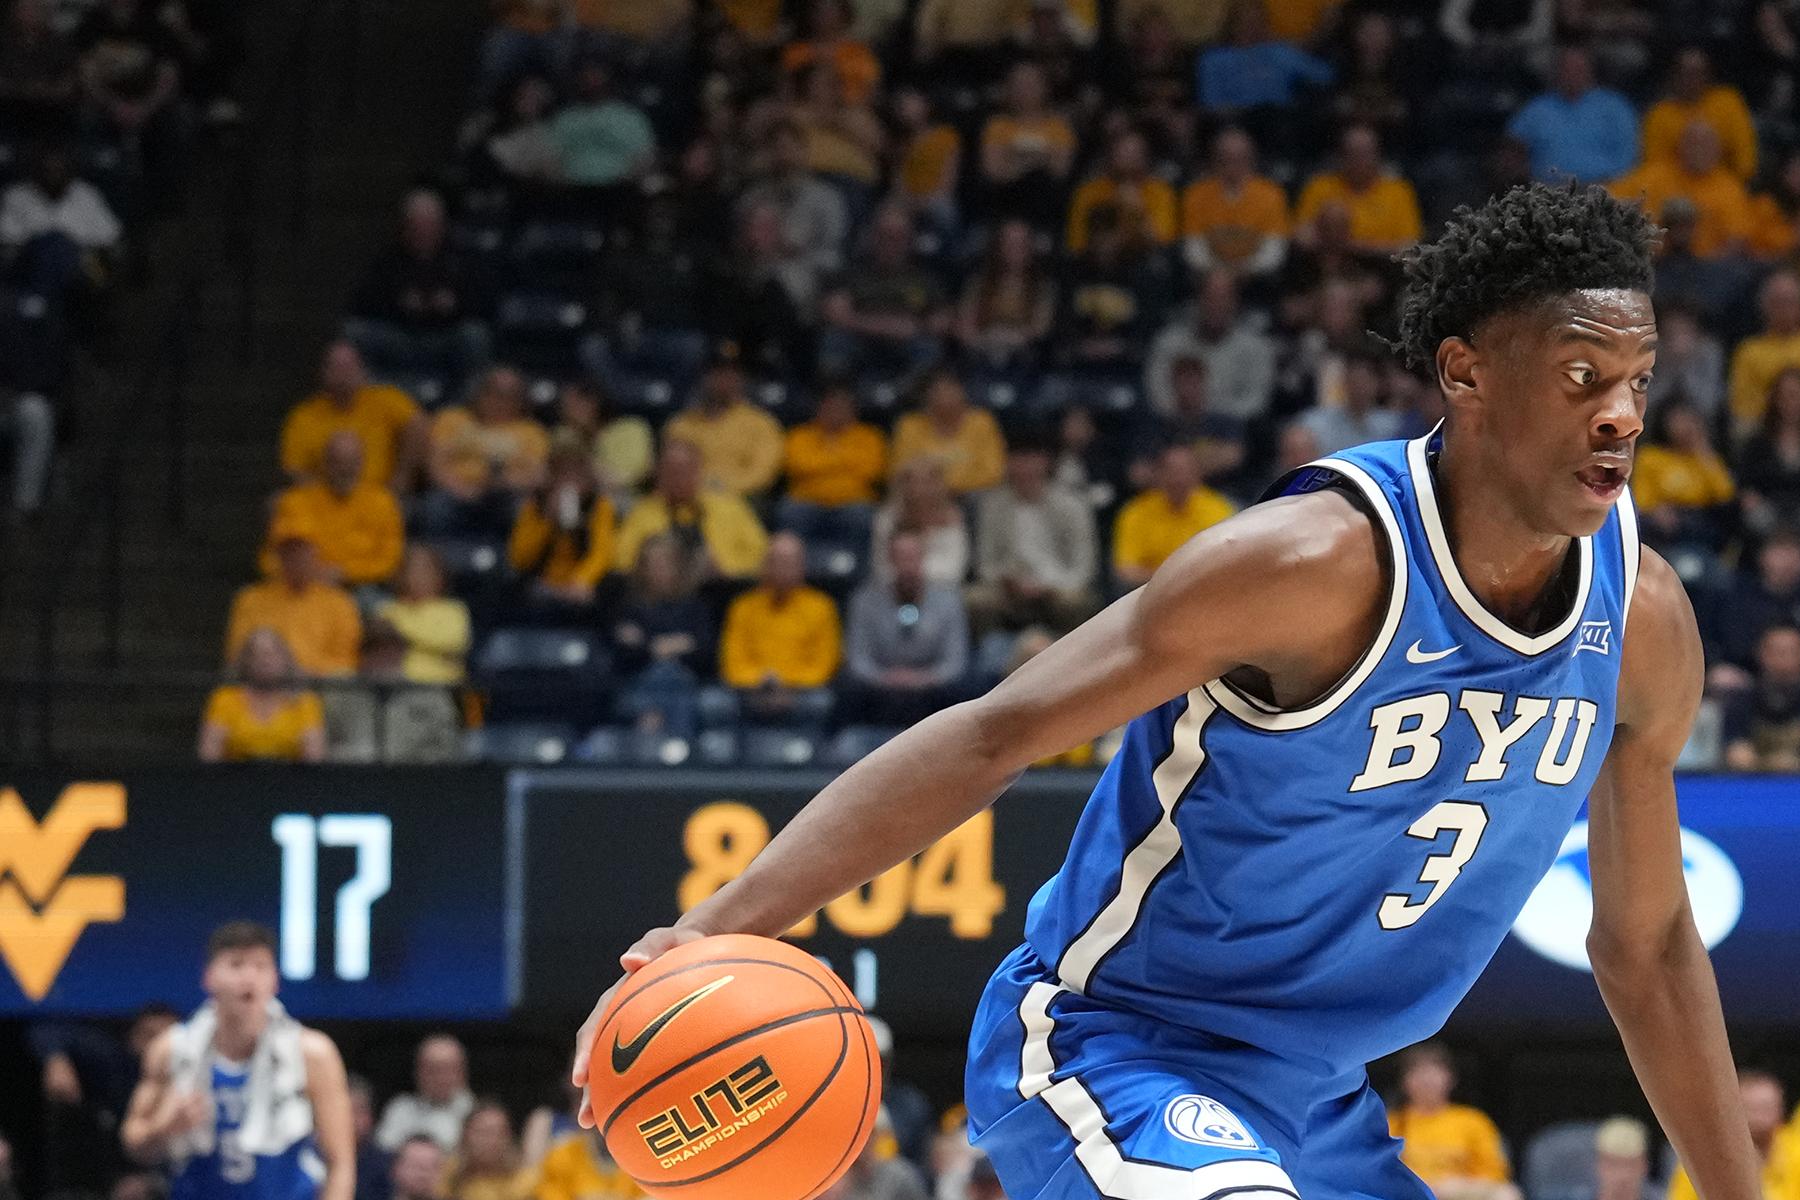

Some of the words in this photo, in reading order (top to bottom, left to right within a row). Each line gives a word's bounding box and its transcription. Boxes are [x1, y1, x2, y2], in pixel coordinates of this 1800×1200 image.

[1348, 687, 1599, 793] BYU
[272, 813, 393, 983] 17
[1376, 798, 1490, 930] 3
[636, 1054, 784, 1160] ELITE
[659, 1090, 789, 1170] CHAMPIONSHIP
